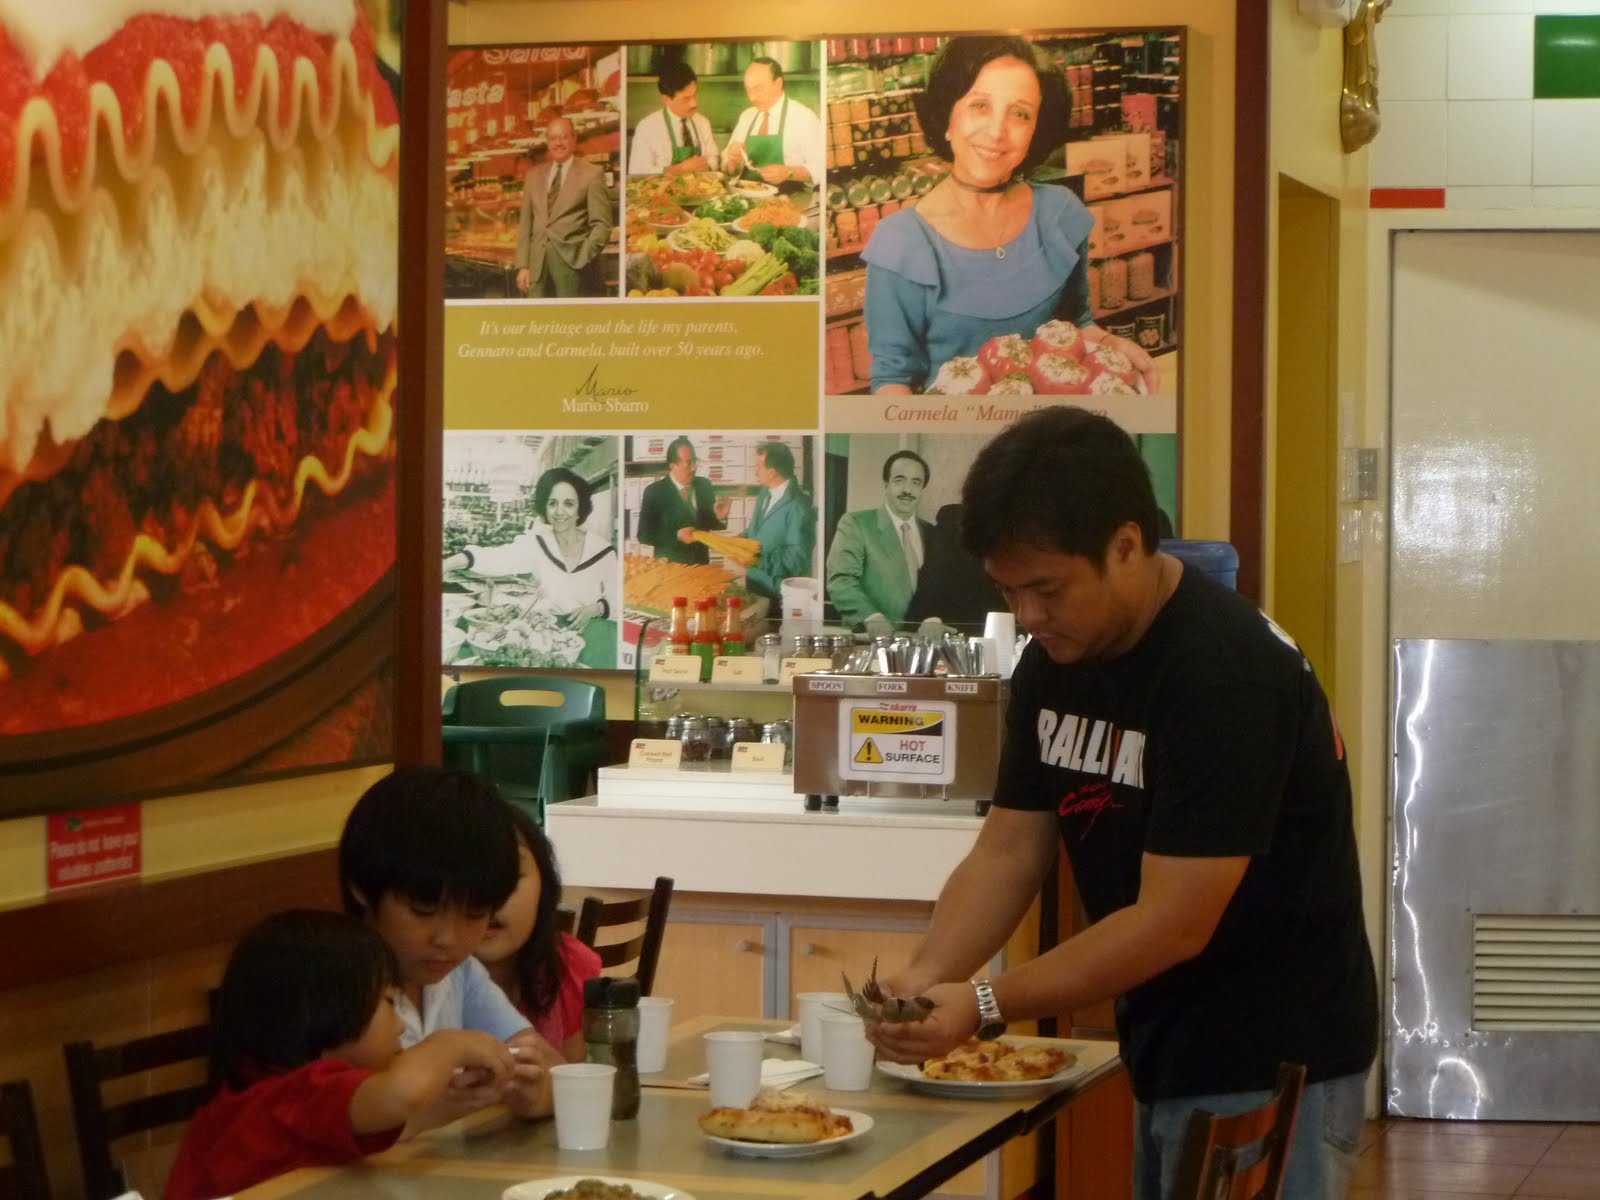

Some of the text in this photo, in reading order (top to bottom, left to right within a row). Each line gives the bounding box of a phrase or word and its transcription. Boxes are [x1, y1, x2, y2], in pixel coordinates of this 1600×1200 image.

[480, 321, 499, 335] It's
[503, 324, 527, 335] our
[528, 320, 583, 337] heritage
[586, 320, 610, 334] and
[614, 320, 633, 334] the
[638, 320, 659, 336] life
[662, 324, 682, 336] my
[458, 343, 514, 358] Gennaro
[518, 343, 542, 357] and
[609, 341, 640, 357] built
[643, 346, 672, 357] over
[677, 341, 694, 356] 50
[696, 345, 732, 359] years
[735, 345, 764, 359] ago.
[562, 397, 649, 412] Mario Sbarro
[884, 404, 958, 422] Carmela
[811, 682, 842, 691] SPOON
[879, 682, 905, 692] FORK
[947, 683, 976, 693] KNIFE
[858, 714, 925, 726] WARNING
[900, 739, 927, 752] HOT
[885, 752, 941, 765] SURFACE
